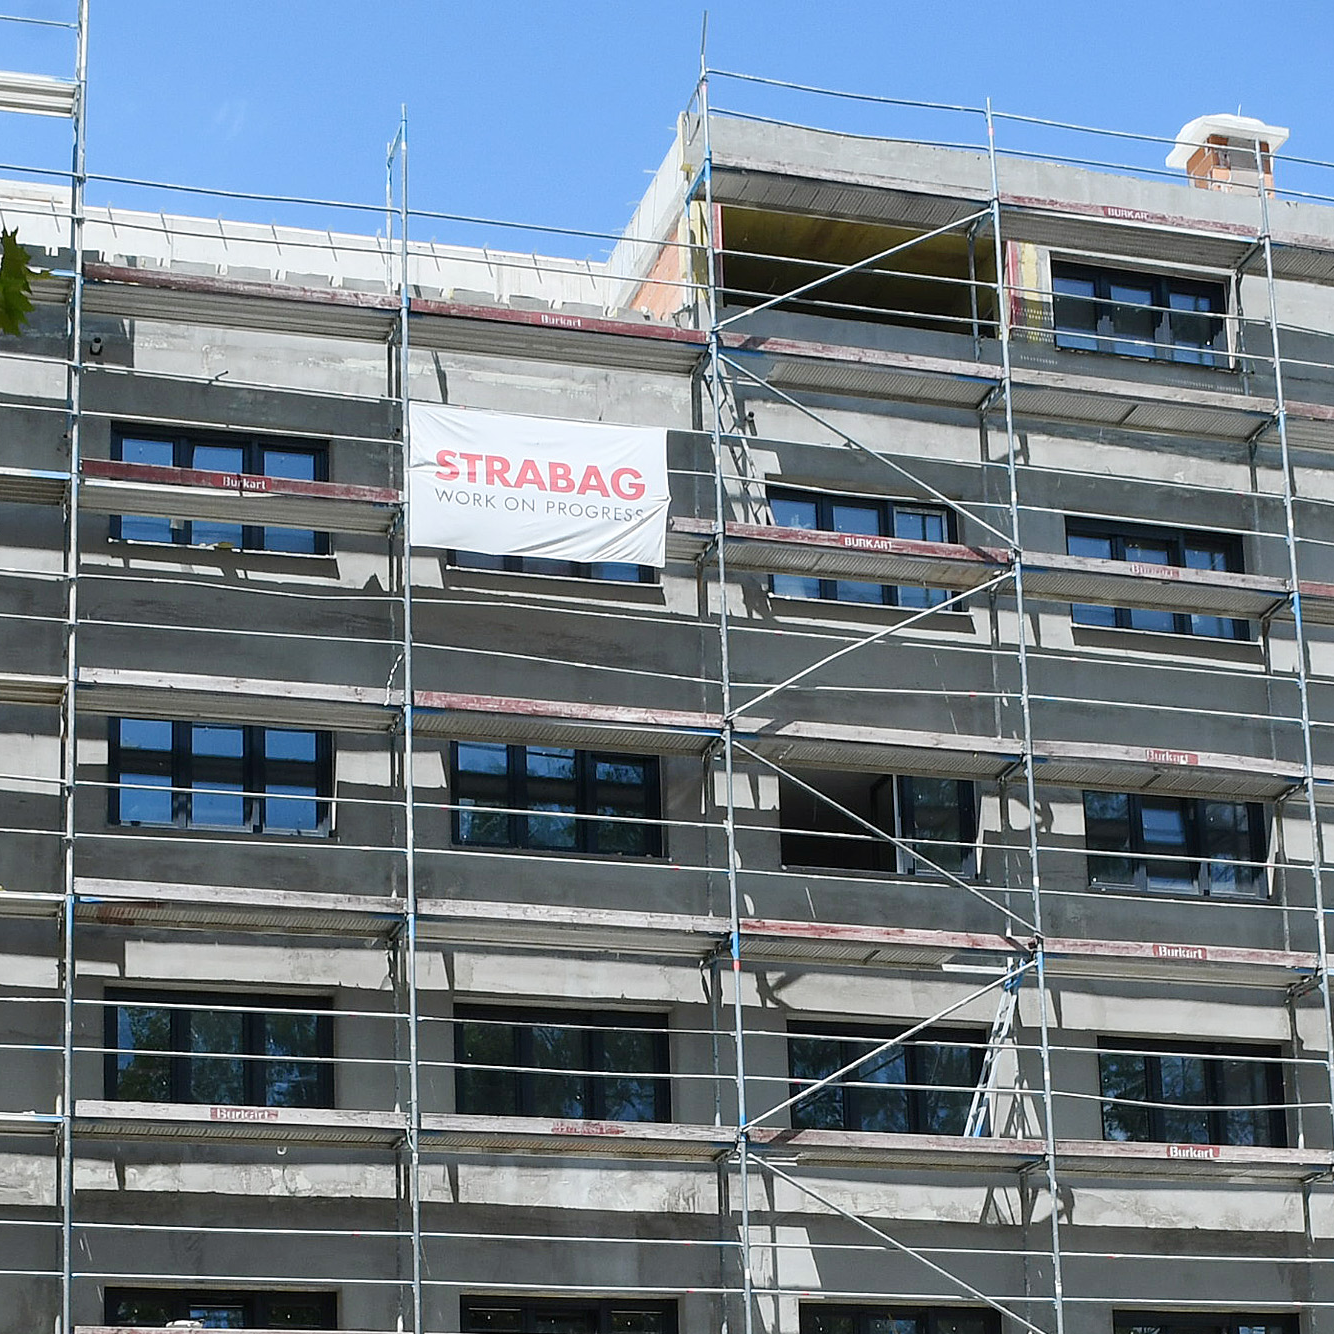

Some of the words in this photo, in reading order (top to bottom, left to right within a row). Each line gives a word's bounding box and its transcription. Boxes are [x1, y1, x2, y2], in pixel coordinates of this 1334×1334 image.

[541, 313, 581, 328] Burkart
[434, 449, 647, 501] STRABAG
[222, 475, 266, 491] Burkart
[434, 487, 497, 510] WORK
[504, 496, 535, 513] ON
[546, 500, 645, 523] PROGRESS
[1158, 945, 1204, 960] Burkart
[1169, 1145, 1214, 1159] Burkart
